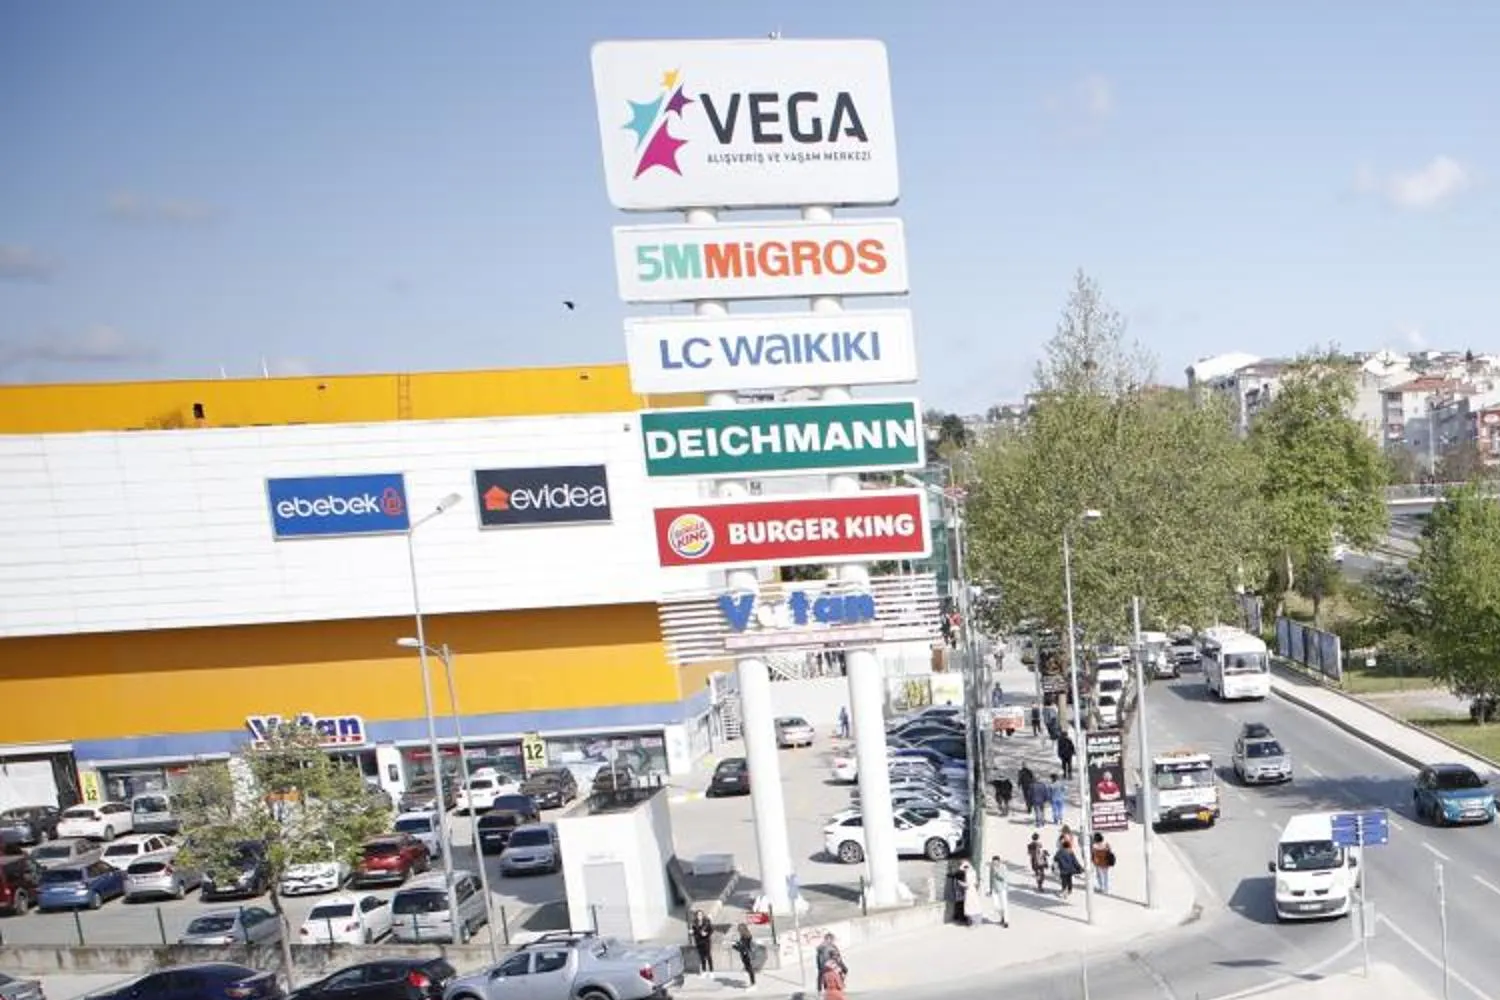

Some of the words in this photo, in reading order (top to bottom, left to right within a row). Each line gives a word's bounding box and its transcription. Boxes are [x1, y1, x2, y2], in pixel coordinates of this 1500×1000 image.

[699, 91, 869, 145] VEGA
[707, 152, 764, 165] ALIŞVERİŞ
[767, 153, 781, 163] VE
[784, 152, 821, 163] YAŞAM
[659, 337, 713, 370] LC
[646, 418, 916, 461] DEICHMANN
[276, 492, 381, 519] ebebek
[510, 483, 607, 511] evidea
[728, 516, 840, 546] BURGER
[844, 513, 916, 539] KING
[525, 743, 545, 760] 12
